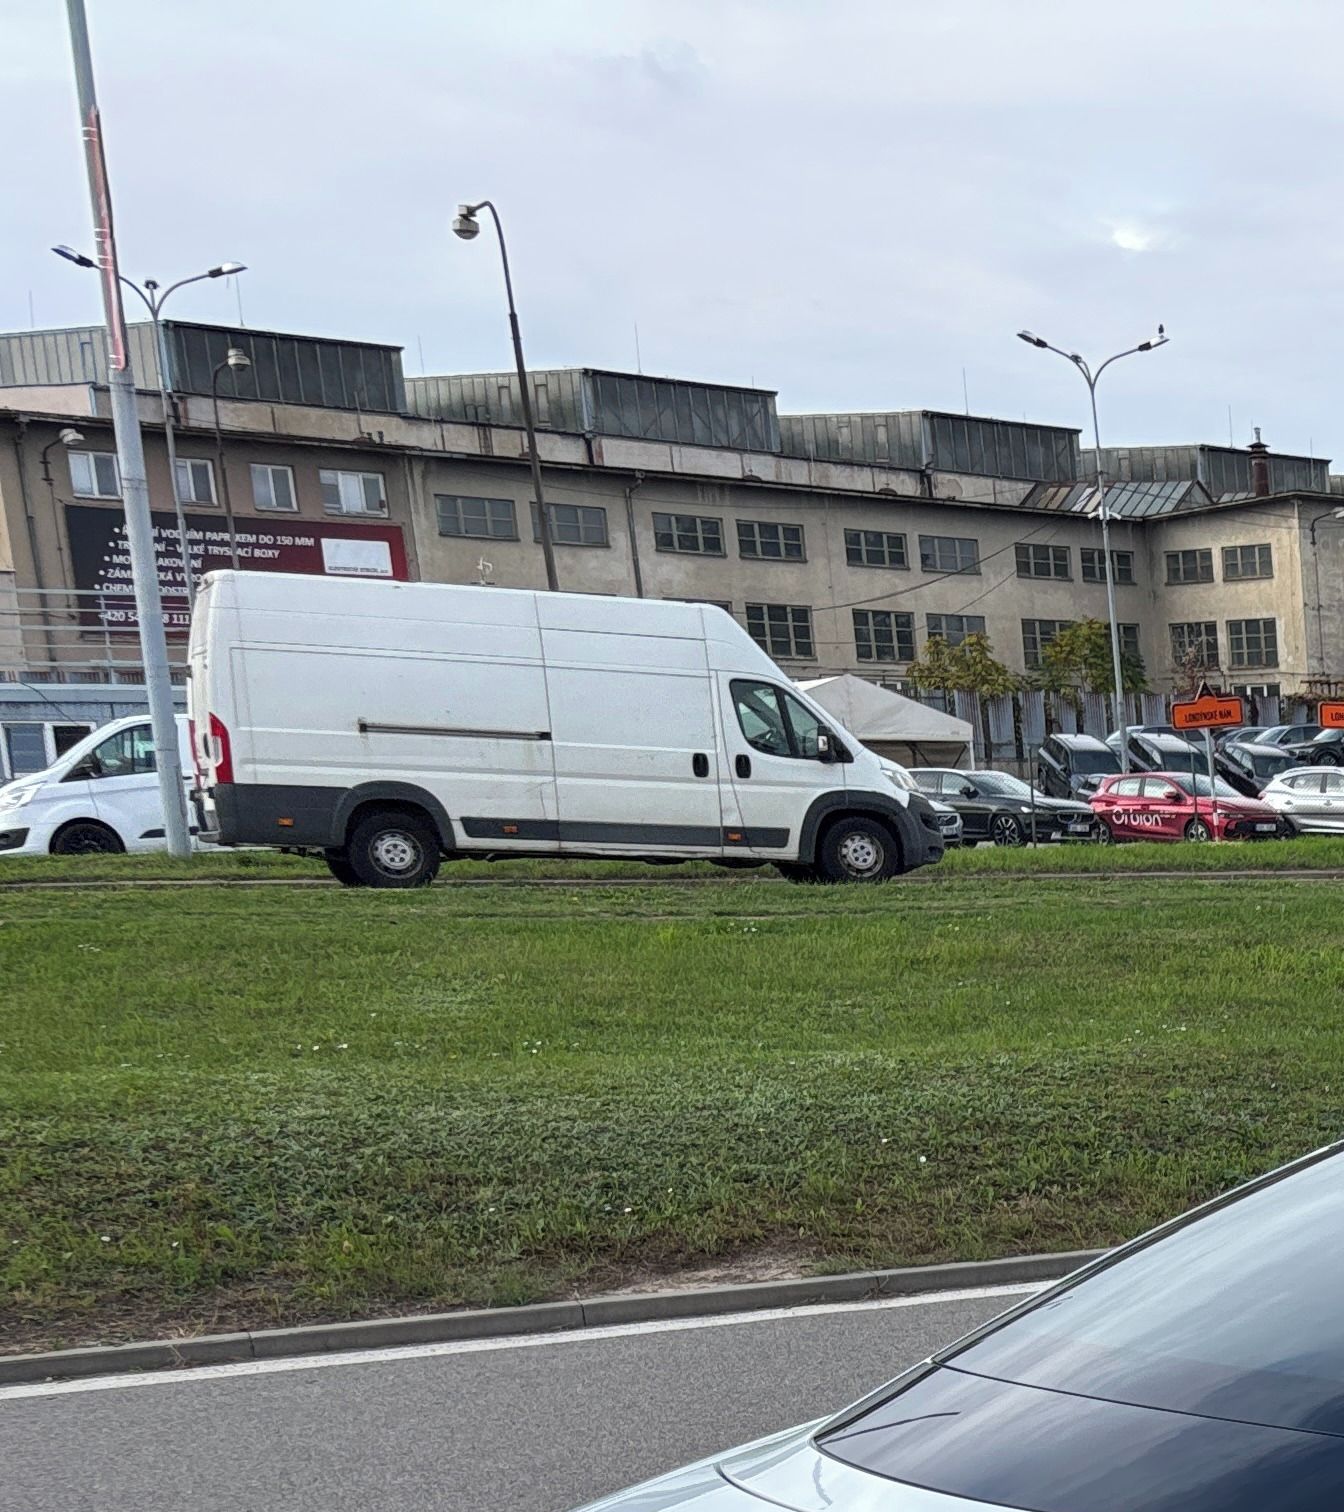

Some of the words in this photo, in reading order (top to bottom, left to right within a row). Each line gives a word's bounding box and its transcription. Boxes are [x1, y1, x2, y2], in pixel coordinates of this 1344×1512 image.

[206, 531, 257, 544] PAPRKEM
[259, 534, 274, 545] DO
[175, 543, 205, 555] VLKÉ
[207, 545, 252, 558] TRYSACÍ
[254, 548, 280, 559] BOXY
